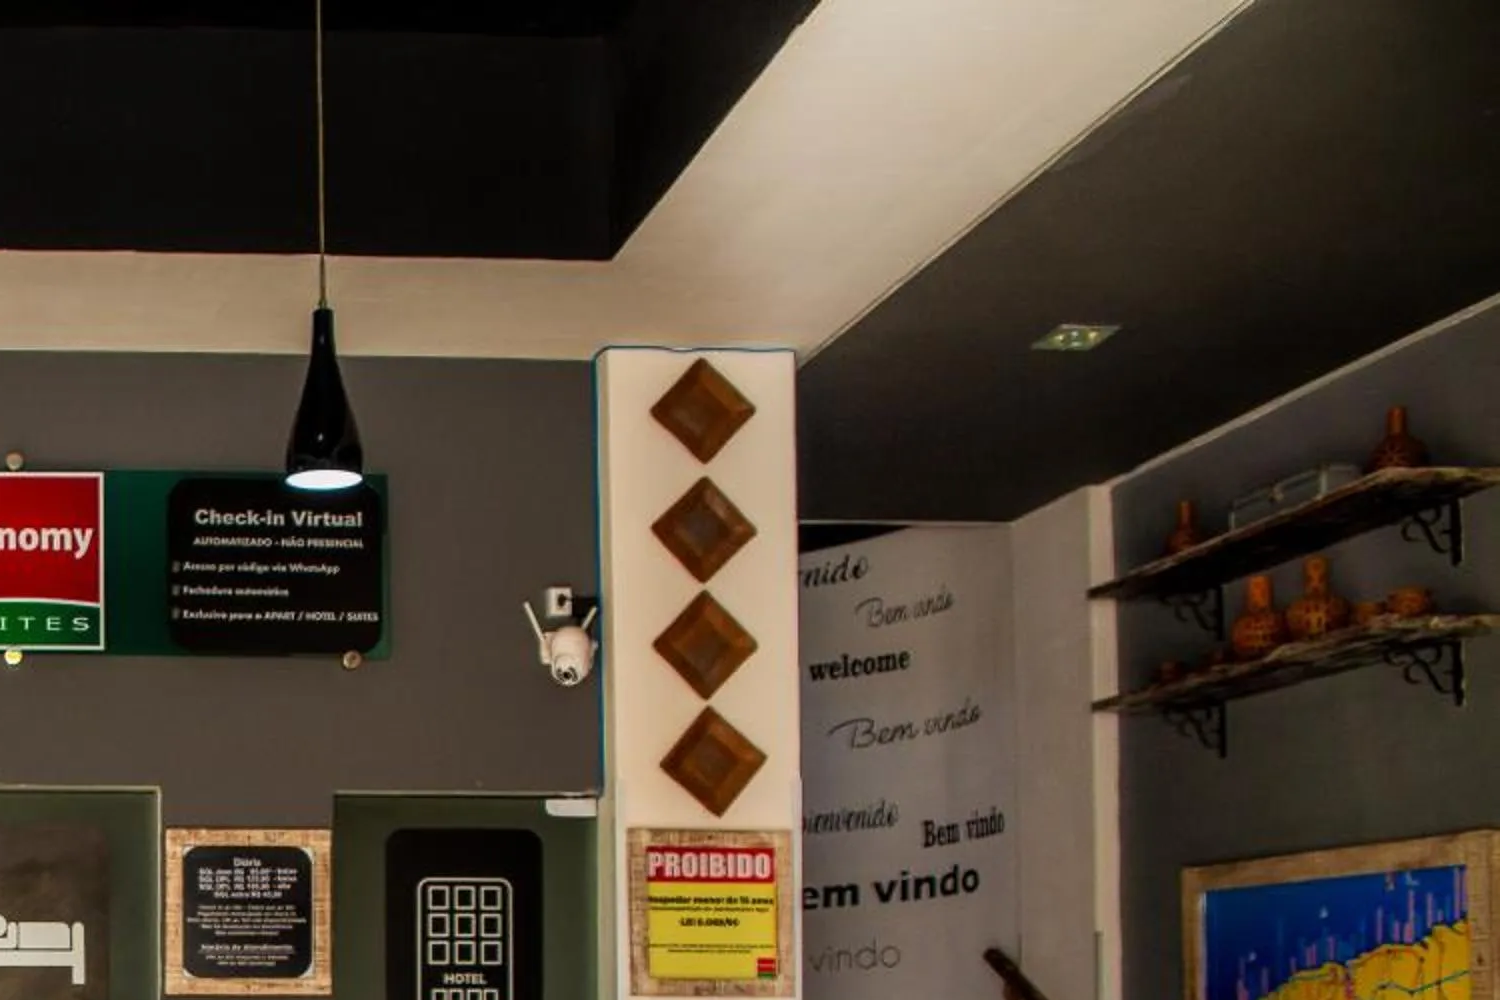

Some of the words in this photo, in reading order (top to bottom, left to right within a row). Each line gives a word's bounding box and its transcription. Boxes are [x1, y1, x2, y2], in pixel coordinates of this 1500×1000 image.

[194, 508, 285, 527] Check-in
[291, 510, 363, 528] Virtual
[193, 536, 272, 547] AUTOMATIZADO
[281, 536, 305, 548] NÃO
[307, 538, 364, 549] PRESENCIAL
[809, 650, 912, 682] welcome
[826, 717, 920, 749] Bem
[920, 818, 961, 848] Bem
[963, 806, 1005, 841] vindo
[648, 852, 772, 879] PROIBIDO
[873, 864, 980, 904] vindo
[807, 938, 901, 973] vindo
[443, 973, 488, 985] HOTEL
